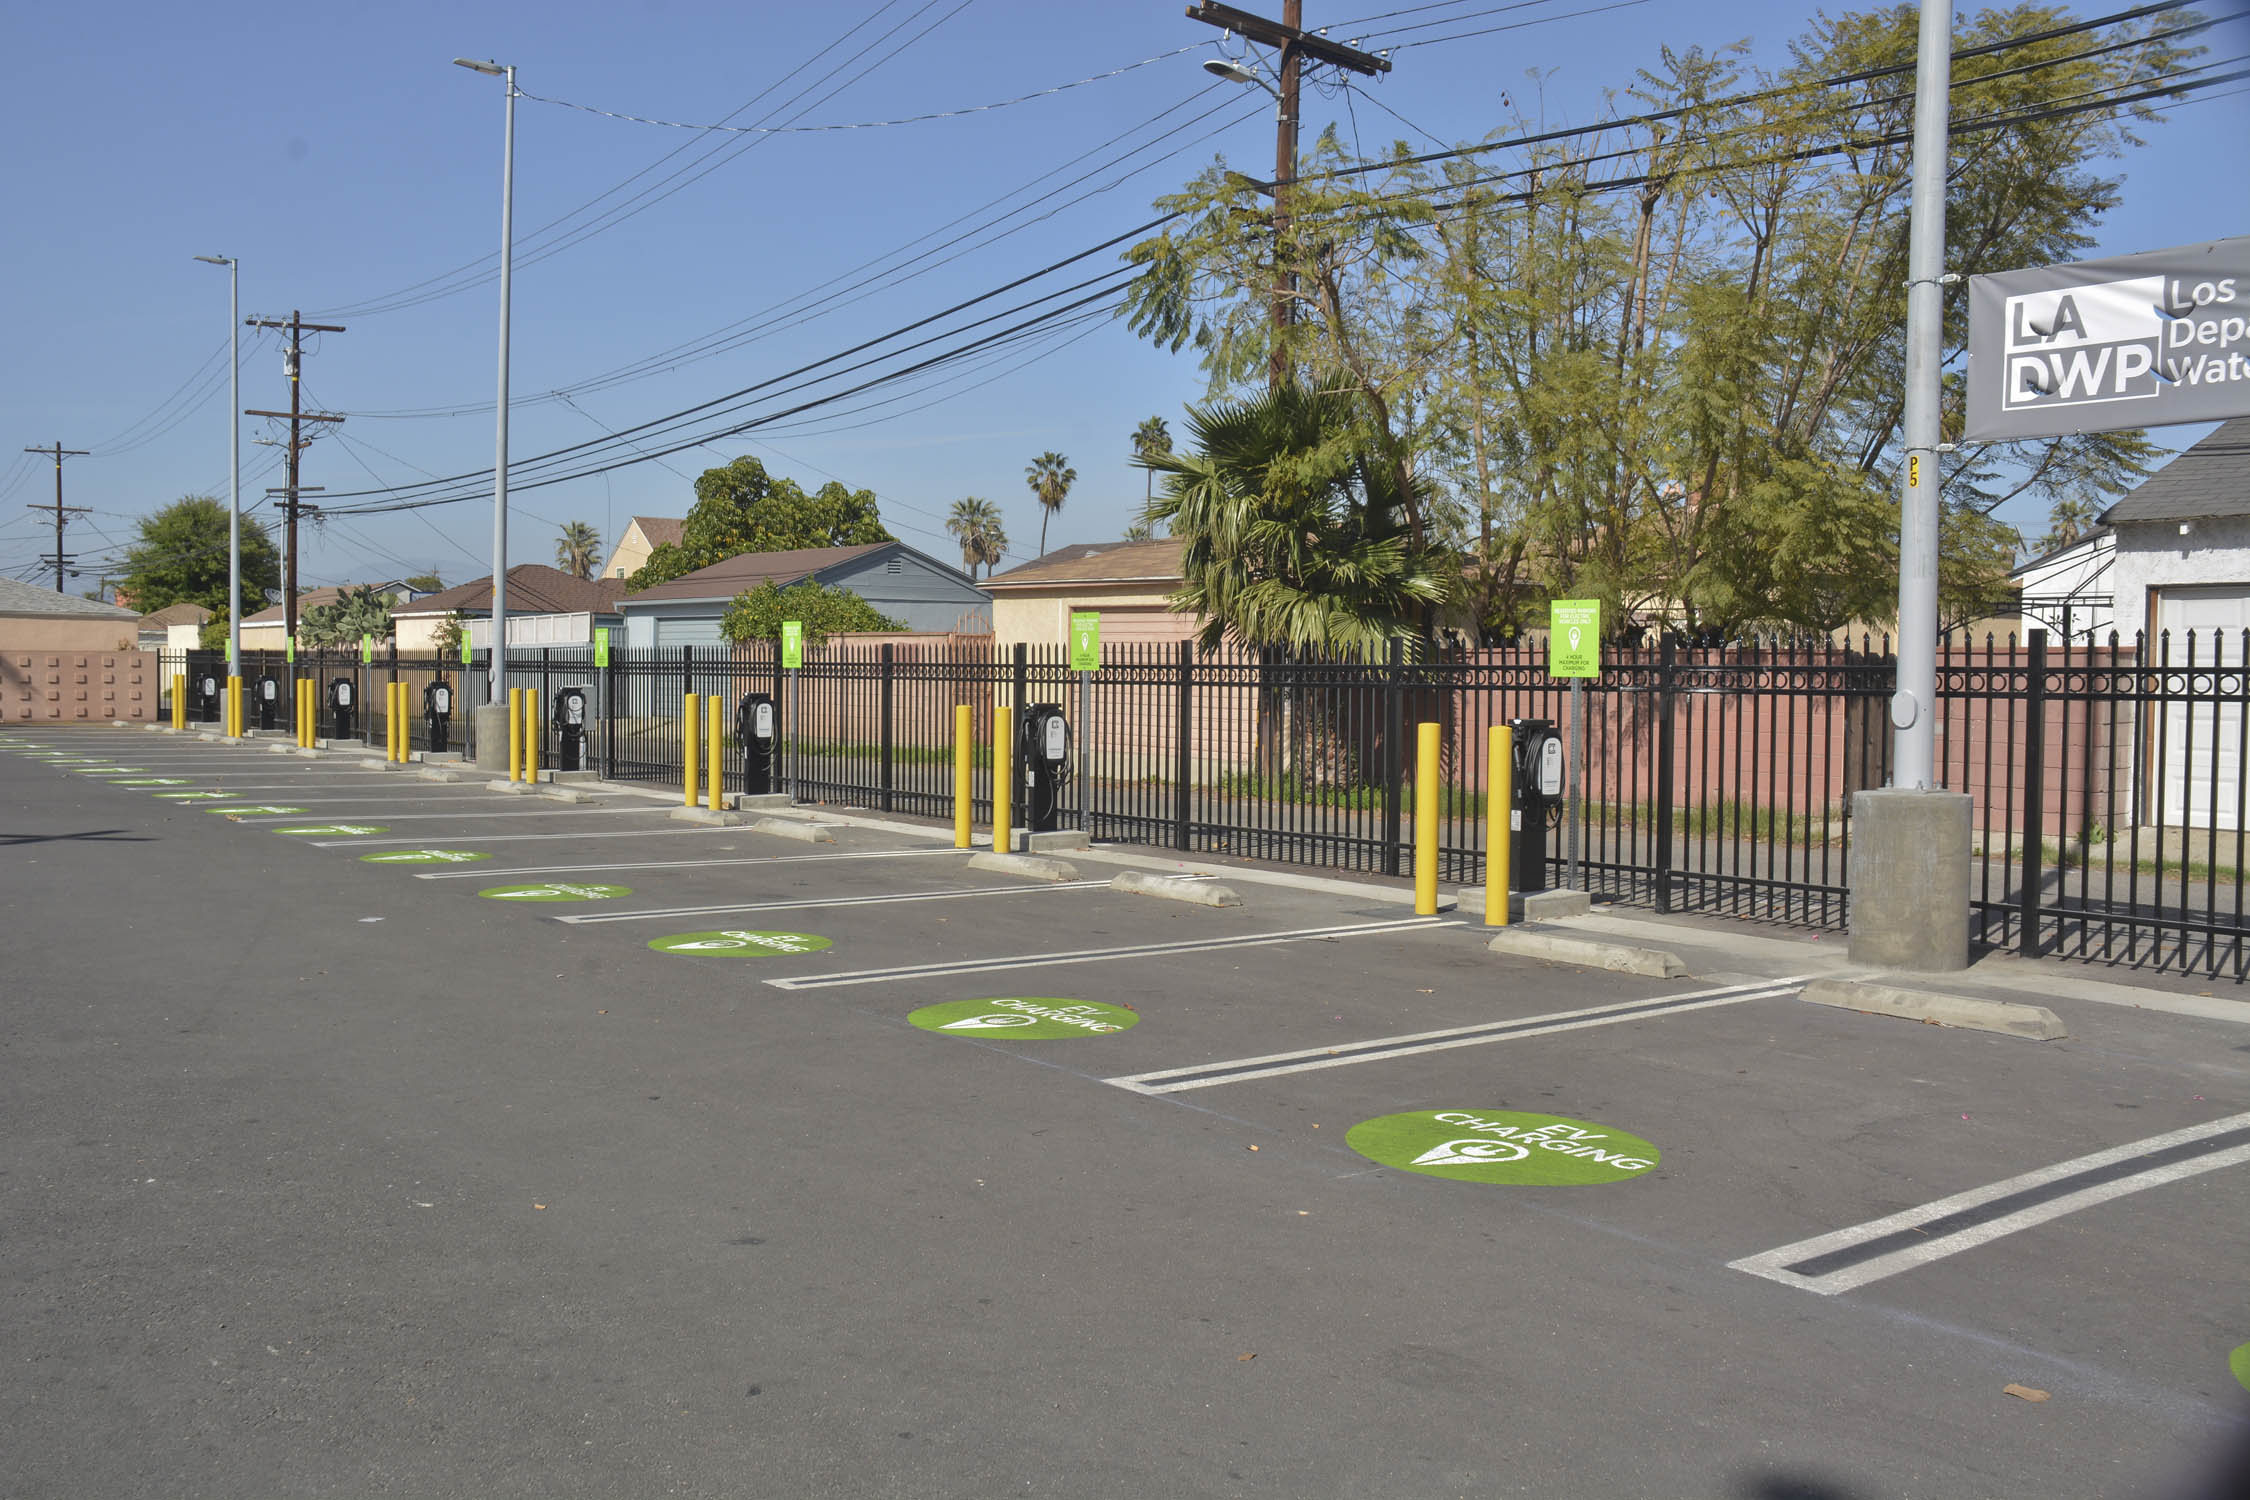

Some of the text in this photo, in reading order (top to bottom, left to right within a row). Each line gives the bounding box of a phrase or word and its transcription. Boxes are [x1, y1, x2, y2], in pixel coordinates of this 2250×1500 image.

[2171, 278, 2236, 310] Los
[2012, 294, 2088, 347] LA
[2010, 344, 2153, 403] DWP
[2167, 352, 2250, 387] Wat
[991, 999, 1124, 1032] CHARGING
[1434, 1112, 1655, 1171] CHARGING
[1534, 1124, 1608, 1140] EV
